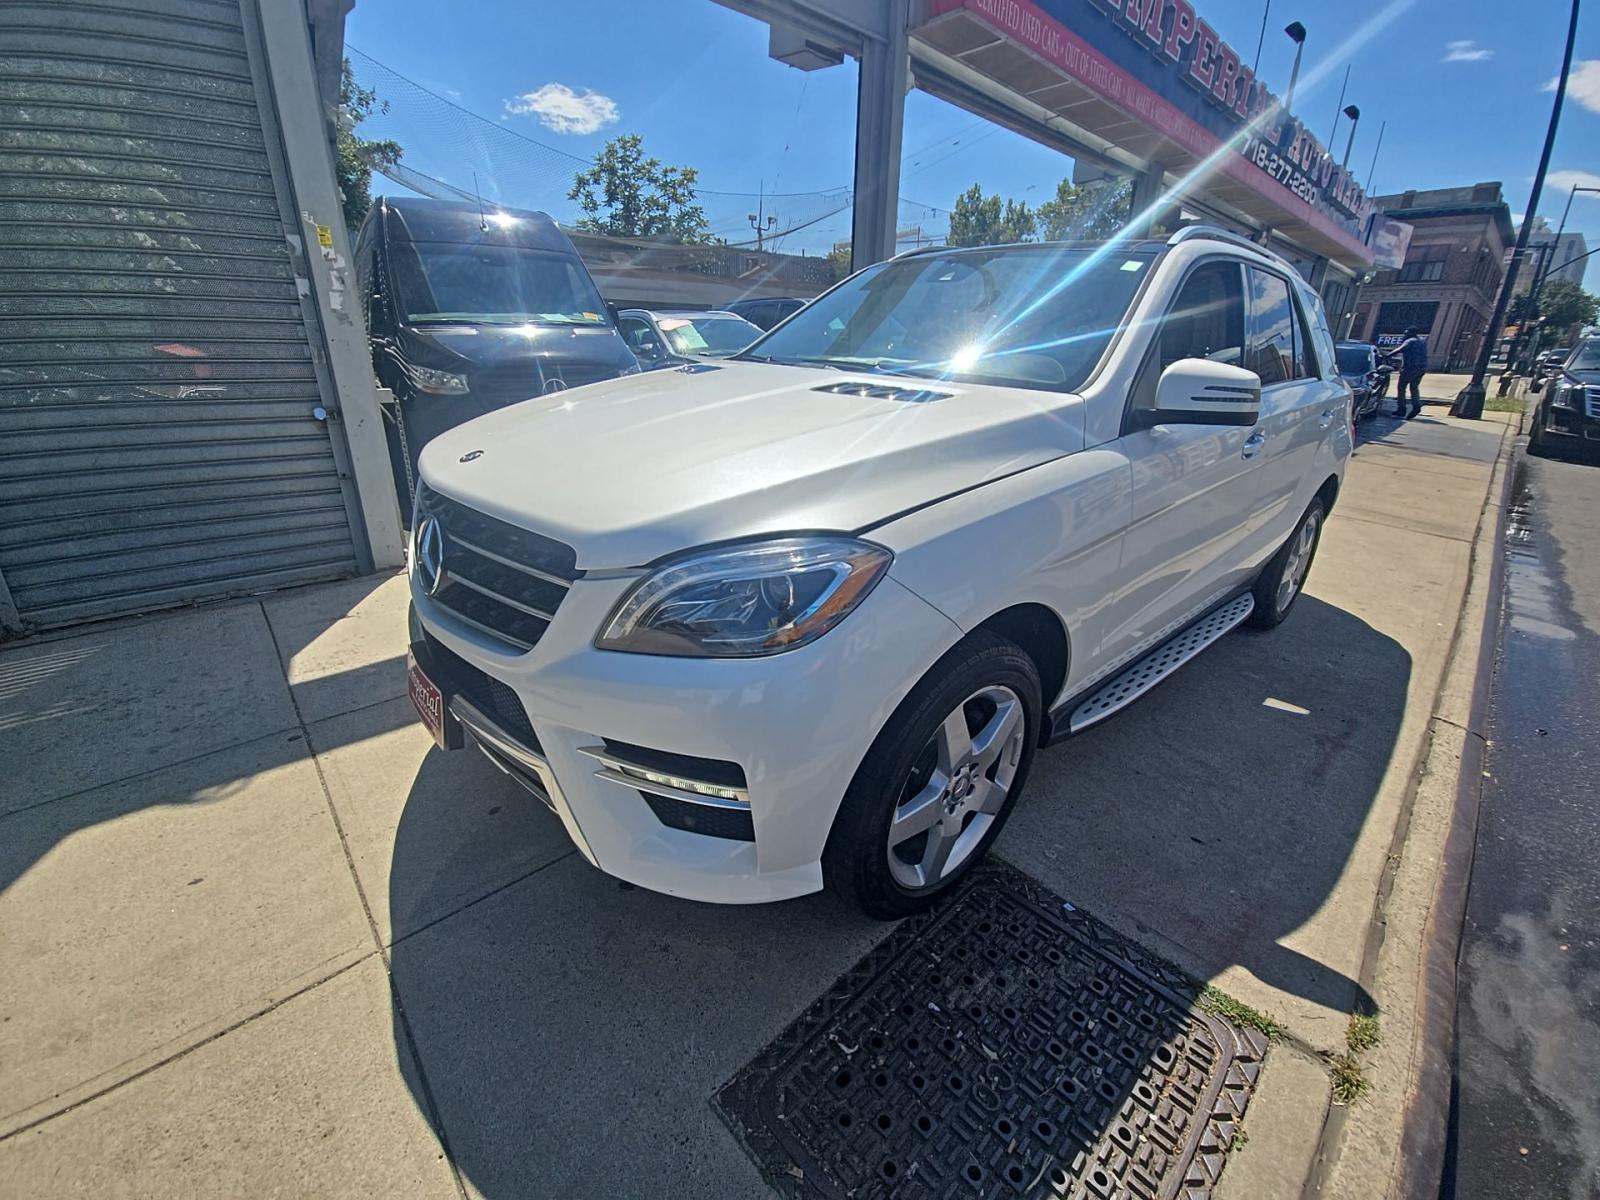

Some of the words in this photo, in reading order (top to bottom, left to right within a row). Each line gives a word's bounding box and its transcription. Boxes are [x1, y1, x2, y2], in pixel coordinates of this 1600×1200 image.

[977, 0, 1020, 30] RTIFIED
[1021, 9, 1041, 44] USED
[1042, 25, 1060, 58] CARS
[1065, 42, 1080, 72] OUT
[1080, 52, 1090, 77] OF
[1107, 0, 1282, 146] MPERIAL
[1242, 135, 1318, 205] 718-277-2200
[1377, 336, 1404, 345] FREE
